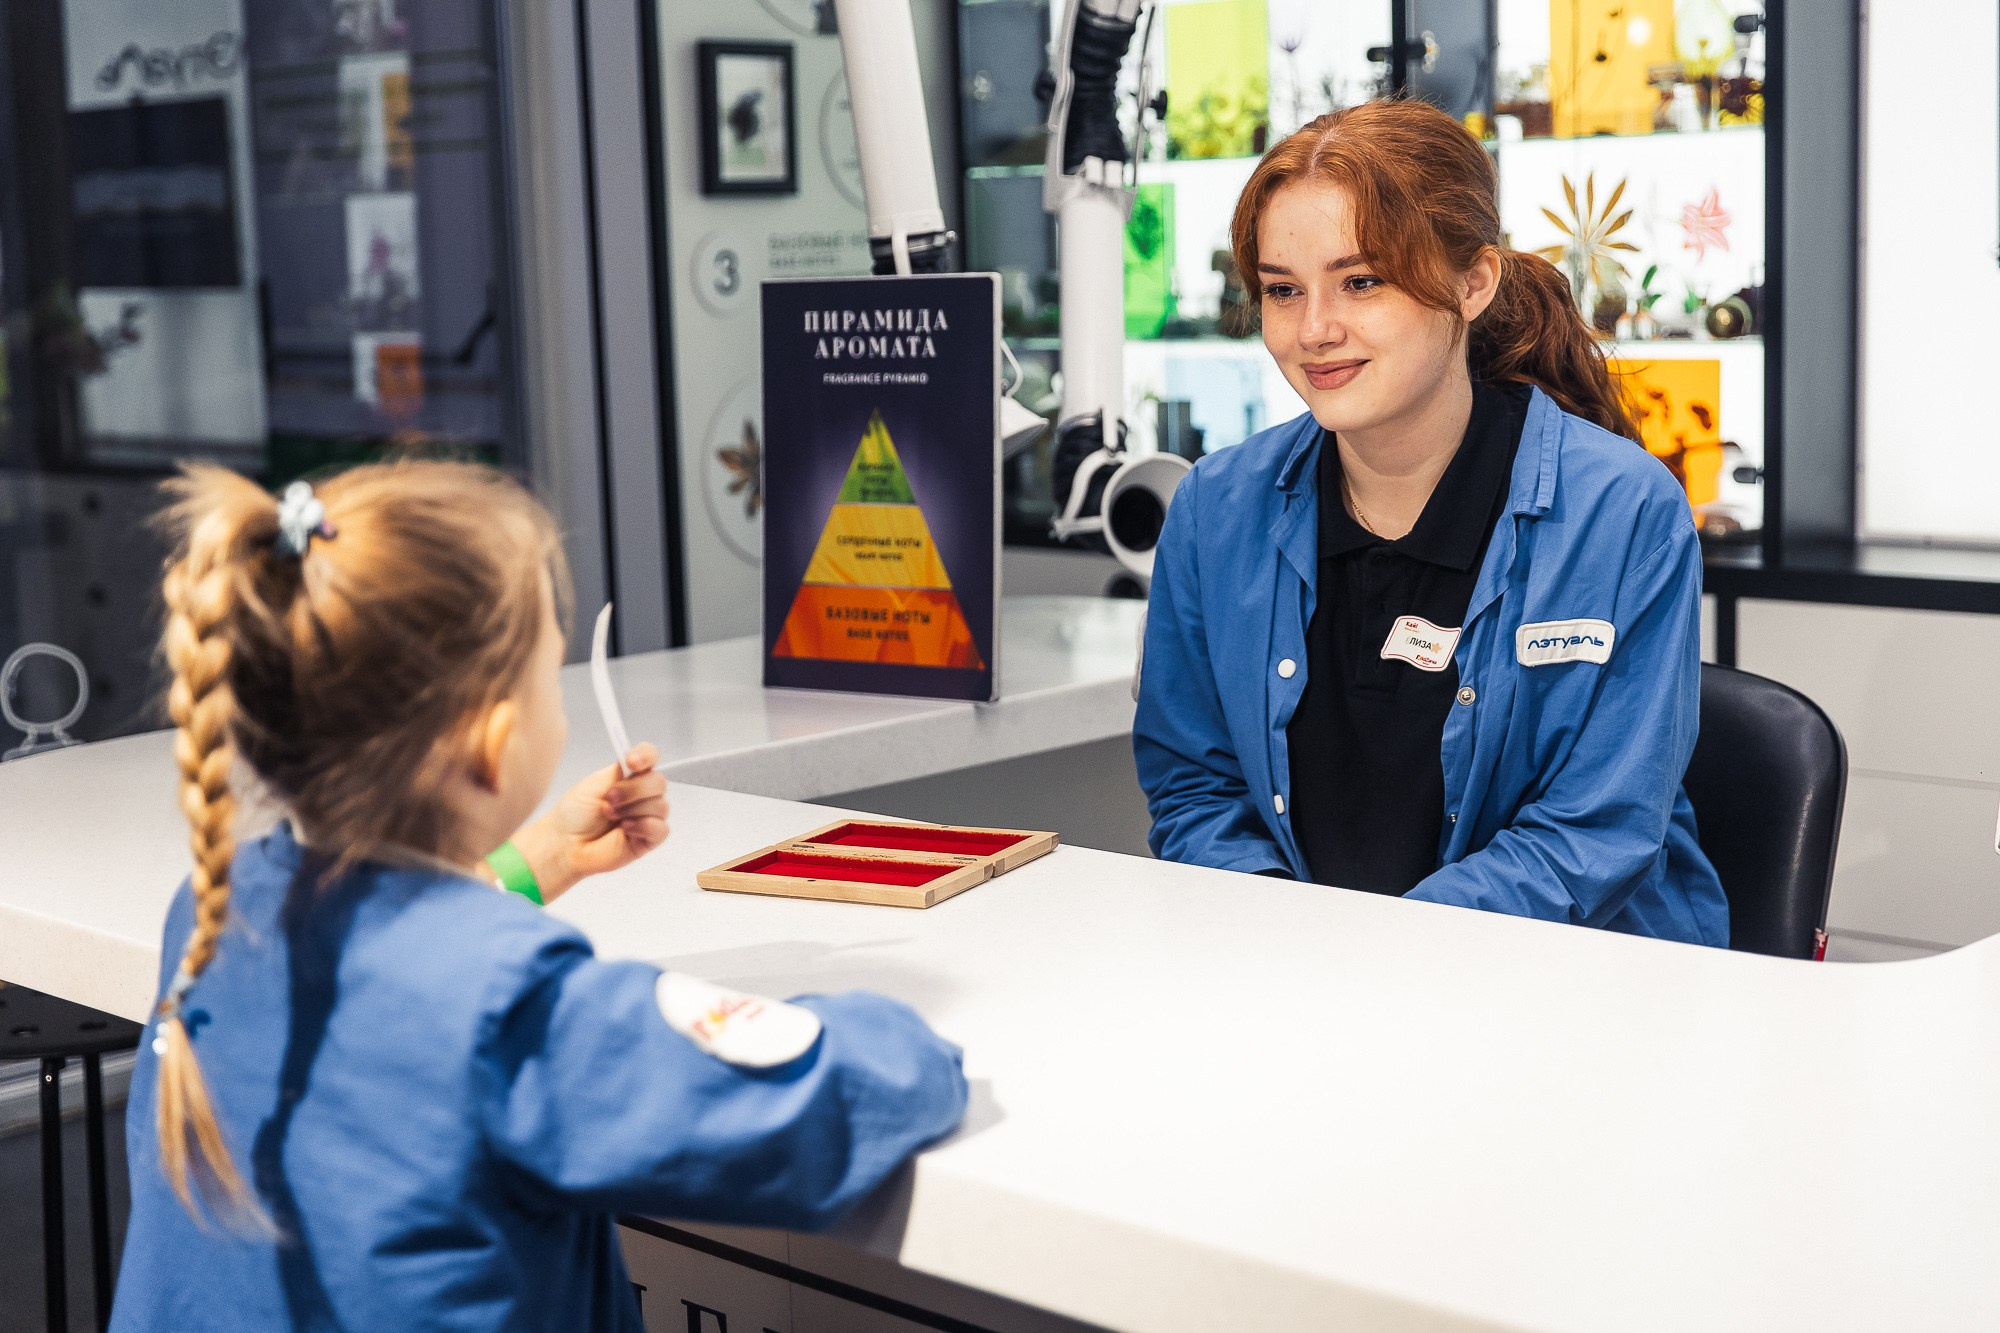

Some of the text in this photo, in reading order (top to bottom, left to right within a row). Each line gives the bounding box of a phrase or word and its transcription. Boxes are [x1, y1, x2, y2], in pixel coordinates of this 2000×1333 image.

[713, 249, 740, 297] 3
[804, 308, 949, 334] ПИРАМИДА
[814, 335, 938, 360] АРОМАТА
[823, 372, 929, 386] FRAGRANCE PYRAMID
[1409, 637, 1432, 650] ЛИЗА
